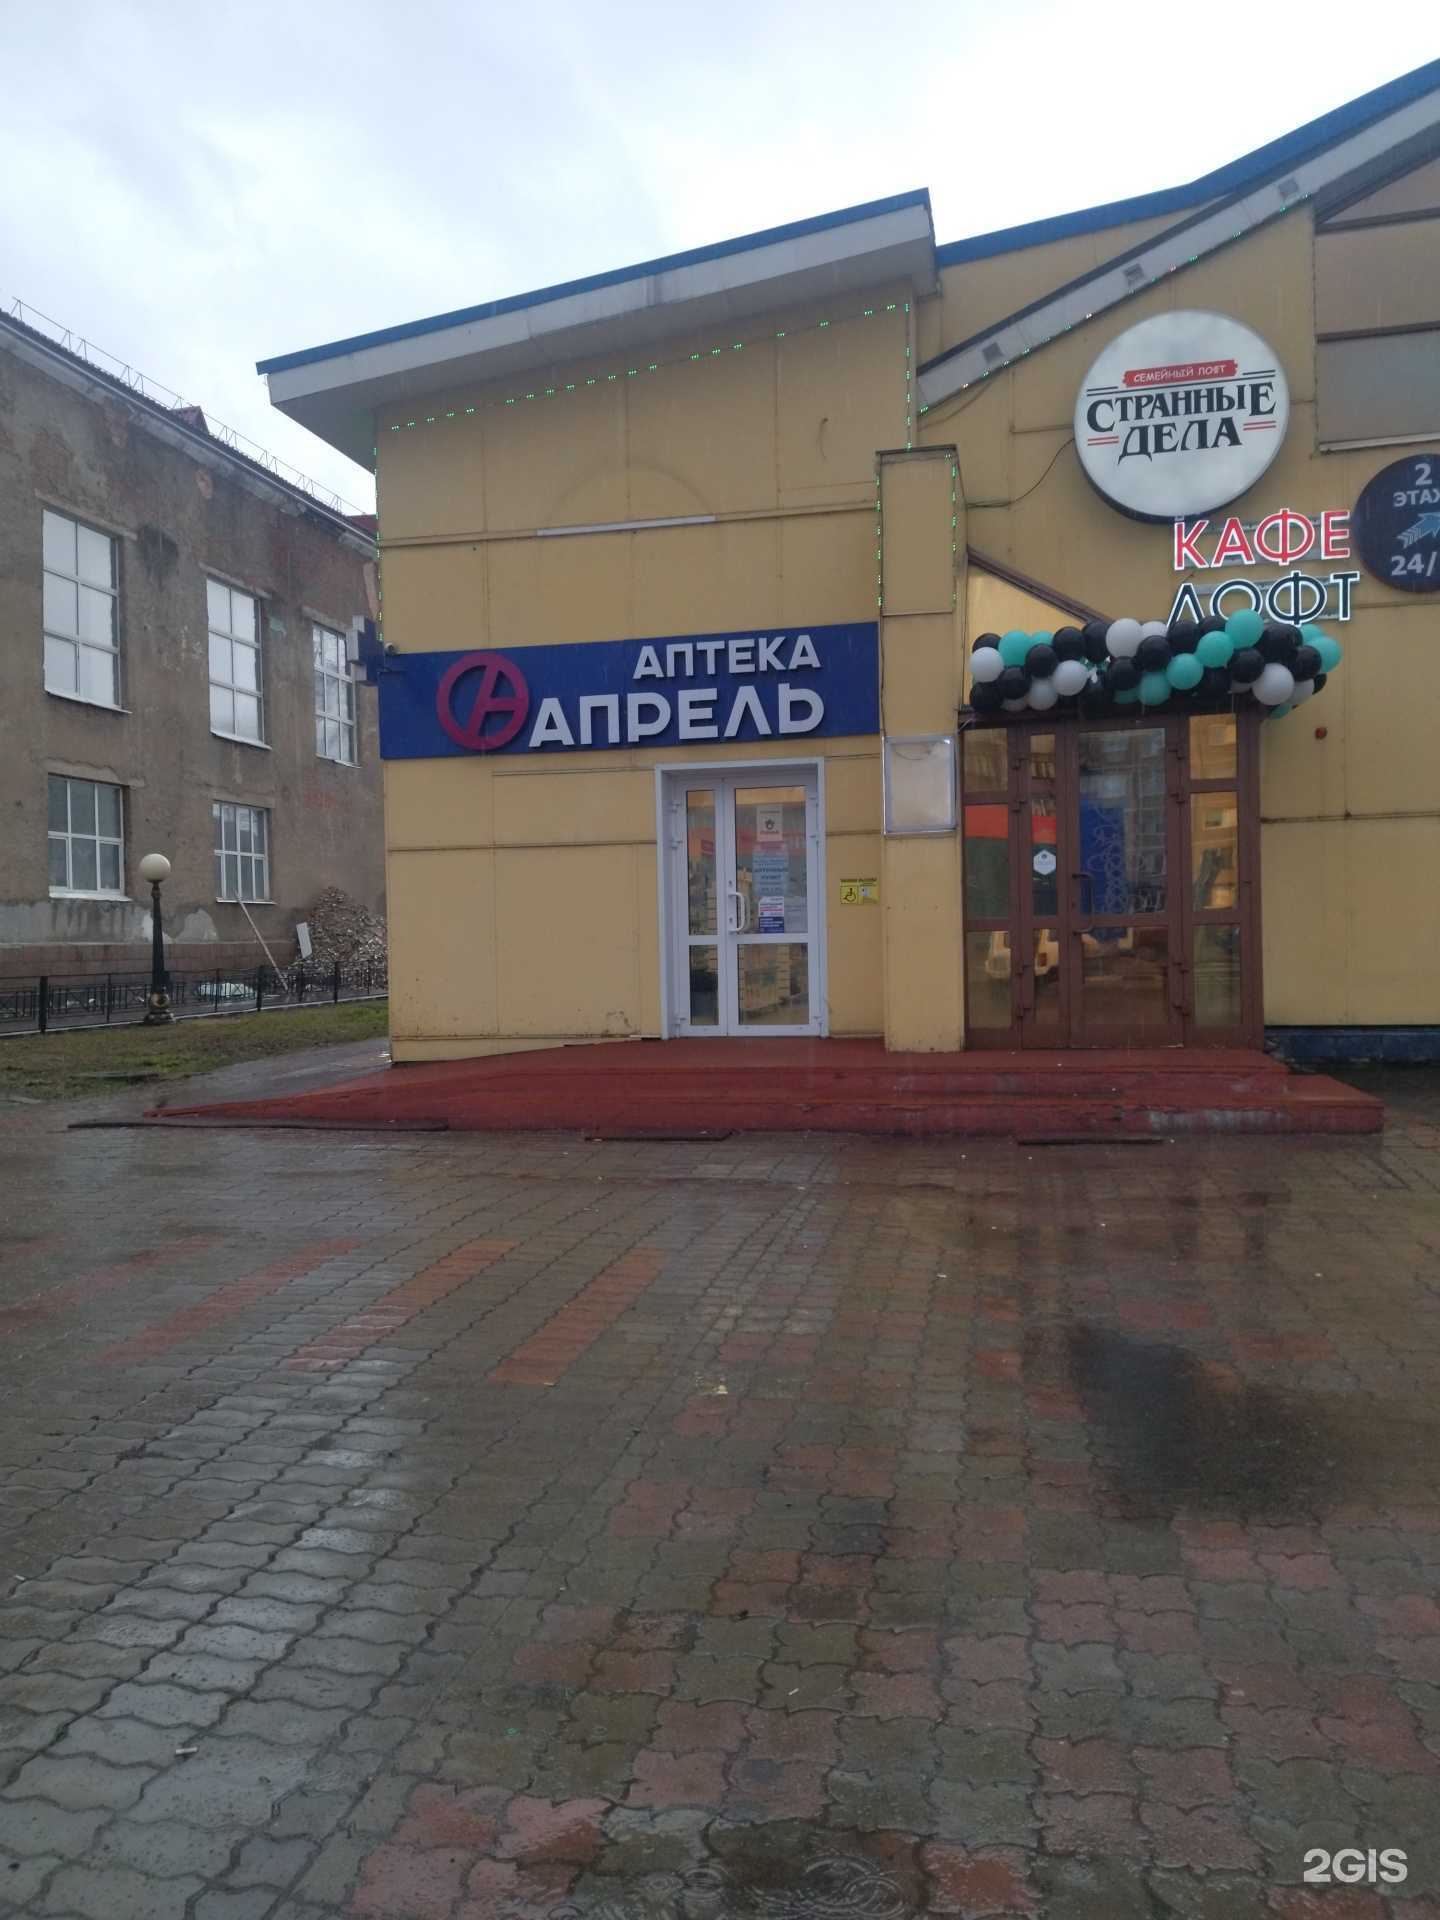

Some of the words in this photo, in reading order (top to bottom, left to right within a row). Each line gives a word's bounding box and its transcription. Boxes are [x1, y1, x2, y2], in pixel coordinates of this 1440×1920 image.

[1133, 366, 1194, 383] СЕМЕЙНЫЙ
[1086, 382, 1277, 433] СТРАННЫЕ
[1117, 416, 1242, 465] ДЕЛА
[1415, 463, 1432, 486] 2
[1174, 508, 1350, 570] КАФЕ
[1166, 570, 1360, 628] ЛОФТ
[633, 634, 821, 680] АПТЕКА
[529, 683, 825, 748] АПРЕЛЬ
